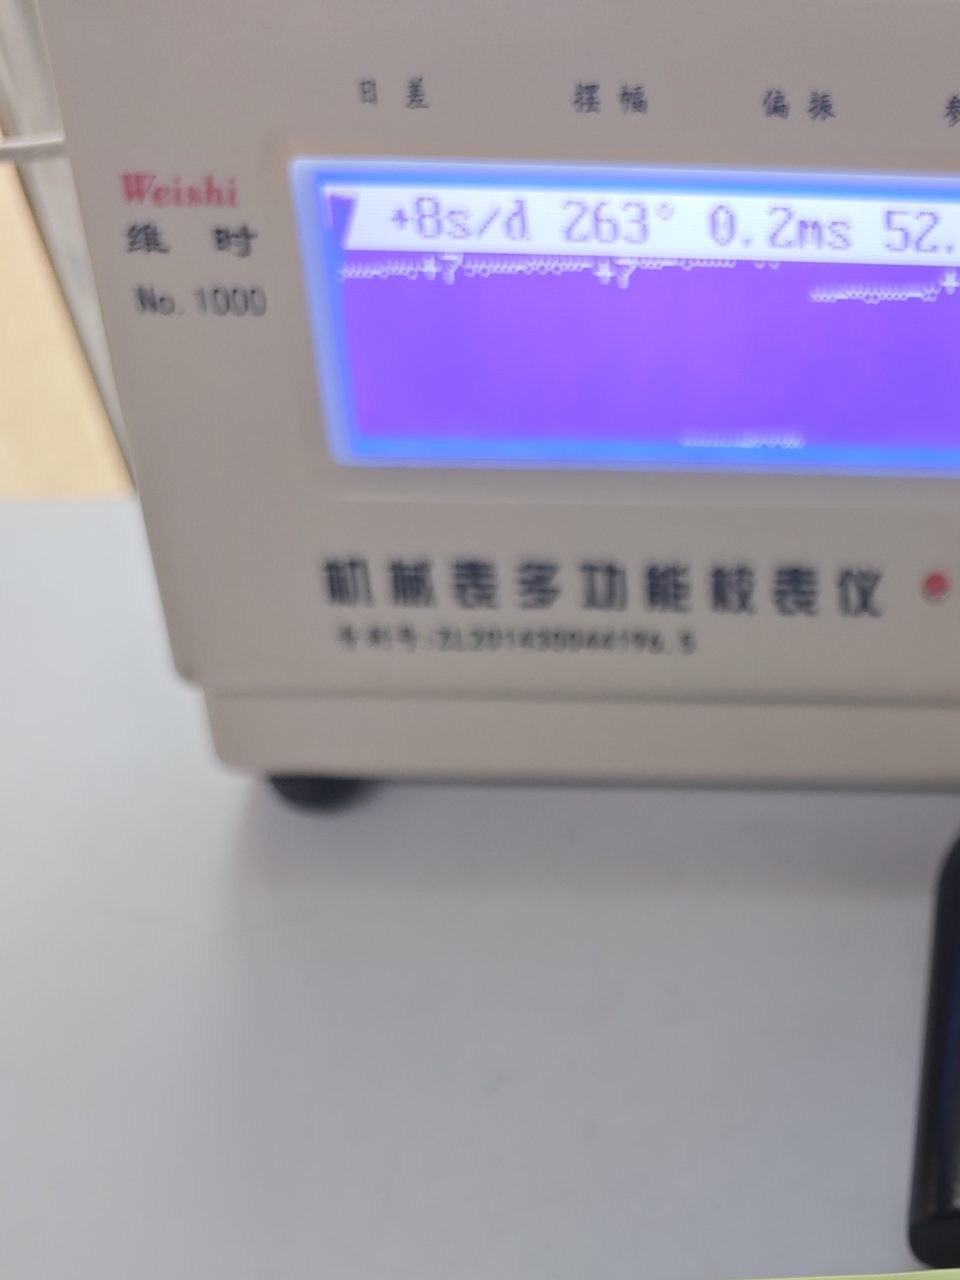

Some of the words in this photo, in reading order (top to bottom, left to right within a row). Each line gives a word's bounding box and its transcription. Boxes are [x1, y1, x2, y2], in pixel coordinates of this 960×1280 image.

[120, 172, 239, 208] Weishi
[391, 196, 533, 243] +8s/d
[708, 203, 854, 251] 0.2ms
